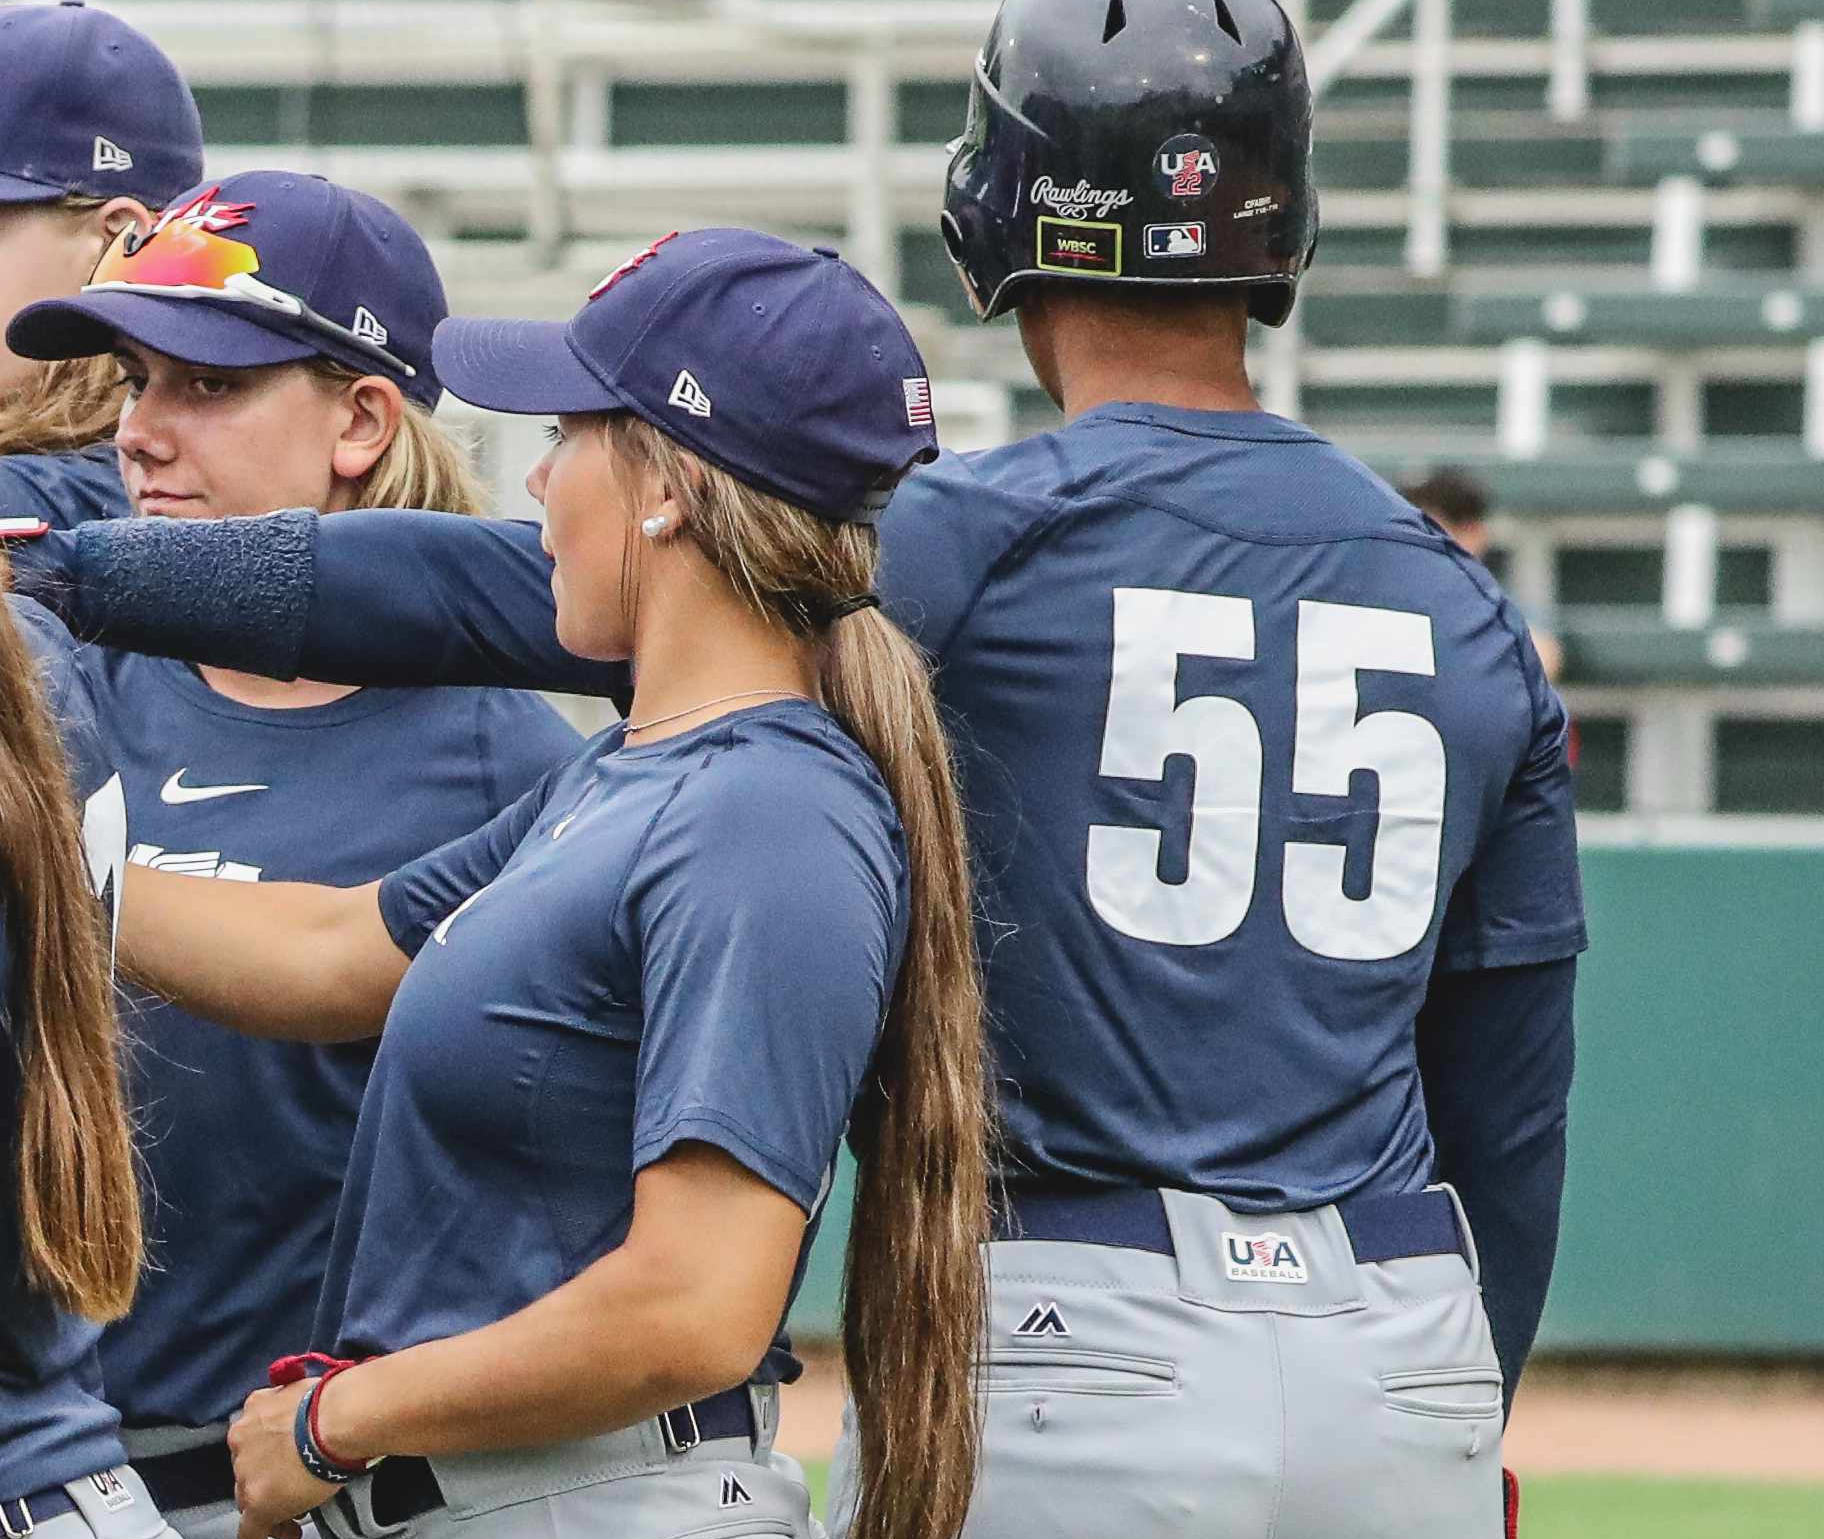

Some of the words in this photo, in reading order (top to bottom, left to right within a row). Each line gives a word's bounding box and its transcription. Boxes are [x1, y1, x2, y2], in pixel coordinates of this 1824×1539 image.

[1031, 175, 1134, 218] Rawlings
[1172, 172, 1201, 195] 22
[1057, 239, 1096, 254] WBSC
[1086, 587, 1447, 960] 55
[1229, 1238, 1301, 1268] USA
[1232, 1268, 1303, 1279] BASEBALL
